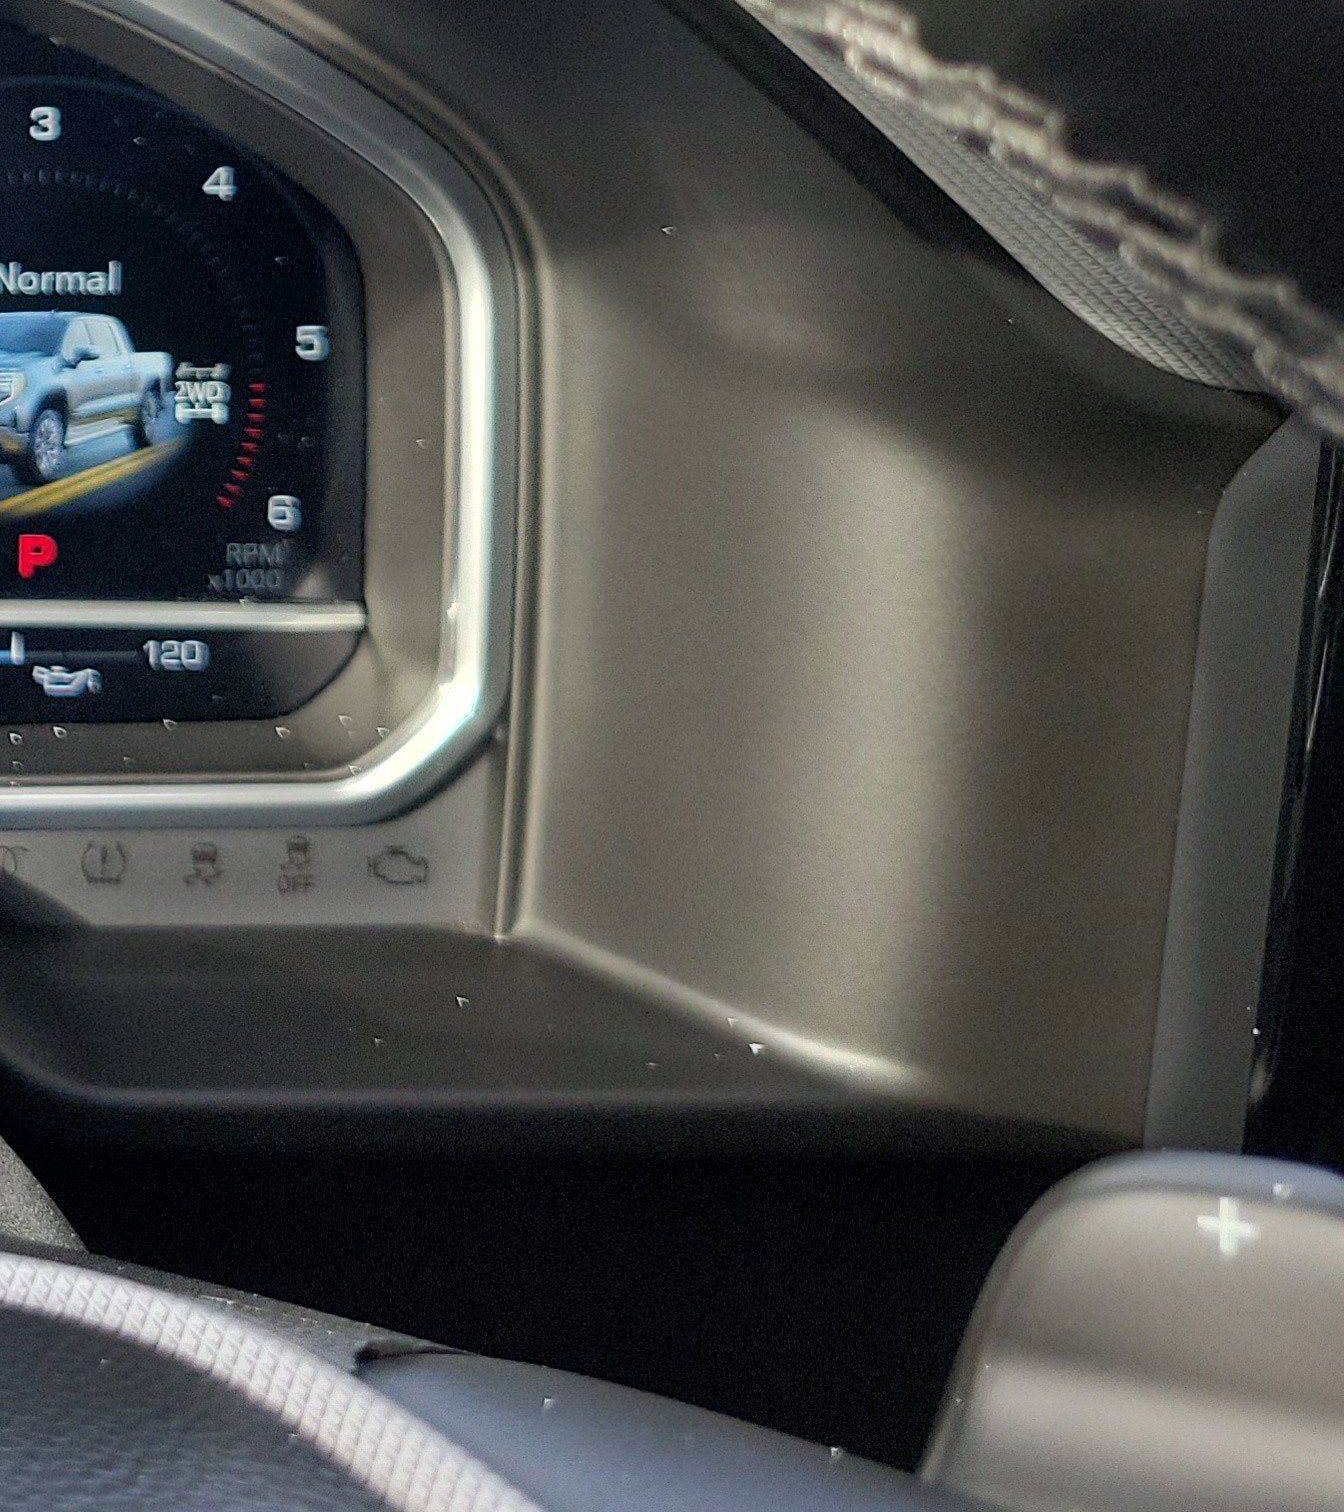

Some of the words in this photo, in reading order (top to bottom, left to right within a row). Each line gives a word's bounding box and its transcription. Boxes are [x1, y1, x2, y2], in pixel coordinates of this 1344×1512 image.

[29, 106, 62, 142] 3
[202, 166, 237, 202] 4
[295, 325, 329, 362] 5
[174, 381, 231, 404] 2WD
[267, 494, 302, 532] 6
[18, 534, 58, 579] P
[226, 542, 285, 568] RPM
[142, 639, 211, 672] 120
